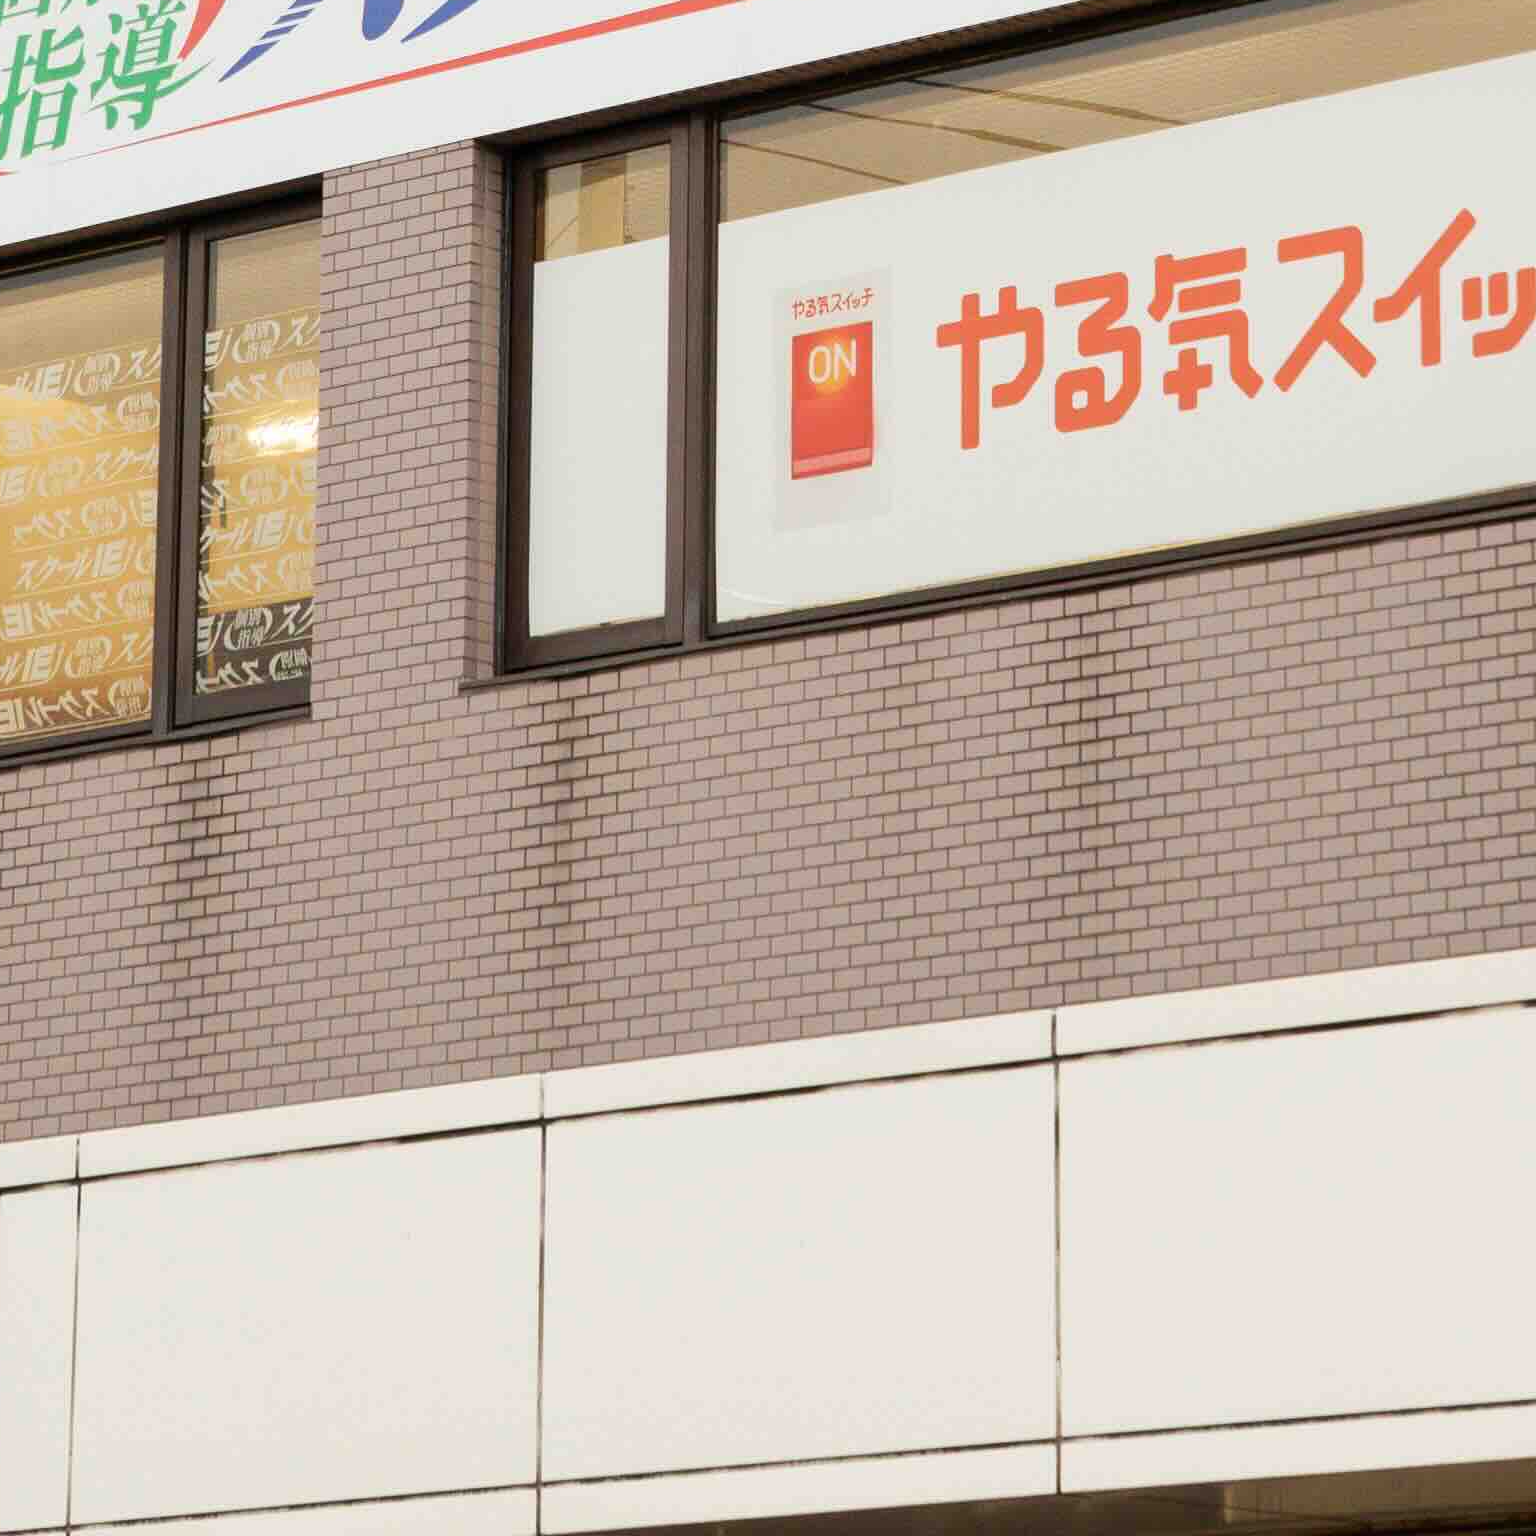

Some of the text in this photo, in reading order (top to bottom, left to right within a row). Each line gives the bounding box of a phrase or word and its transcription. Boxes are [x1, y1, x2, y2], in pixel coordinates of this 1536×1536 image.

[791, 287, 875, 321] やる気スイッチ
[808, 336, 857, 384] ON
